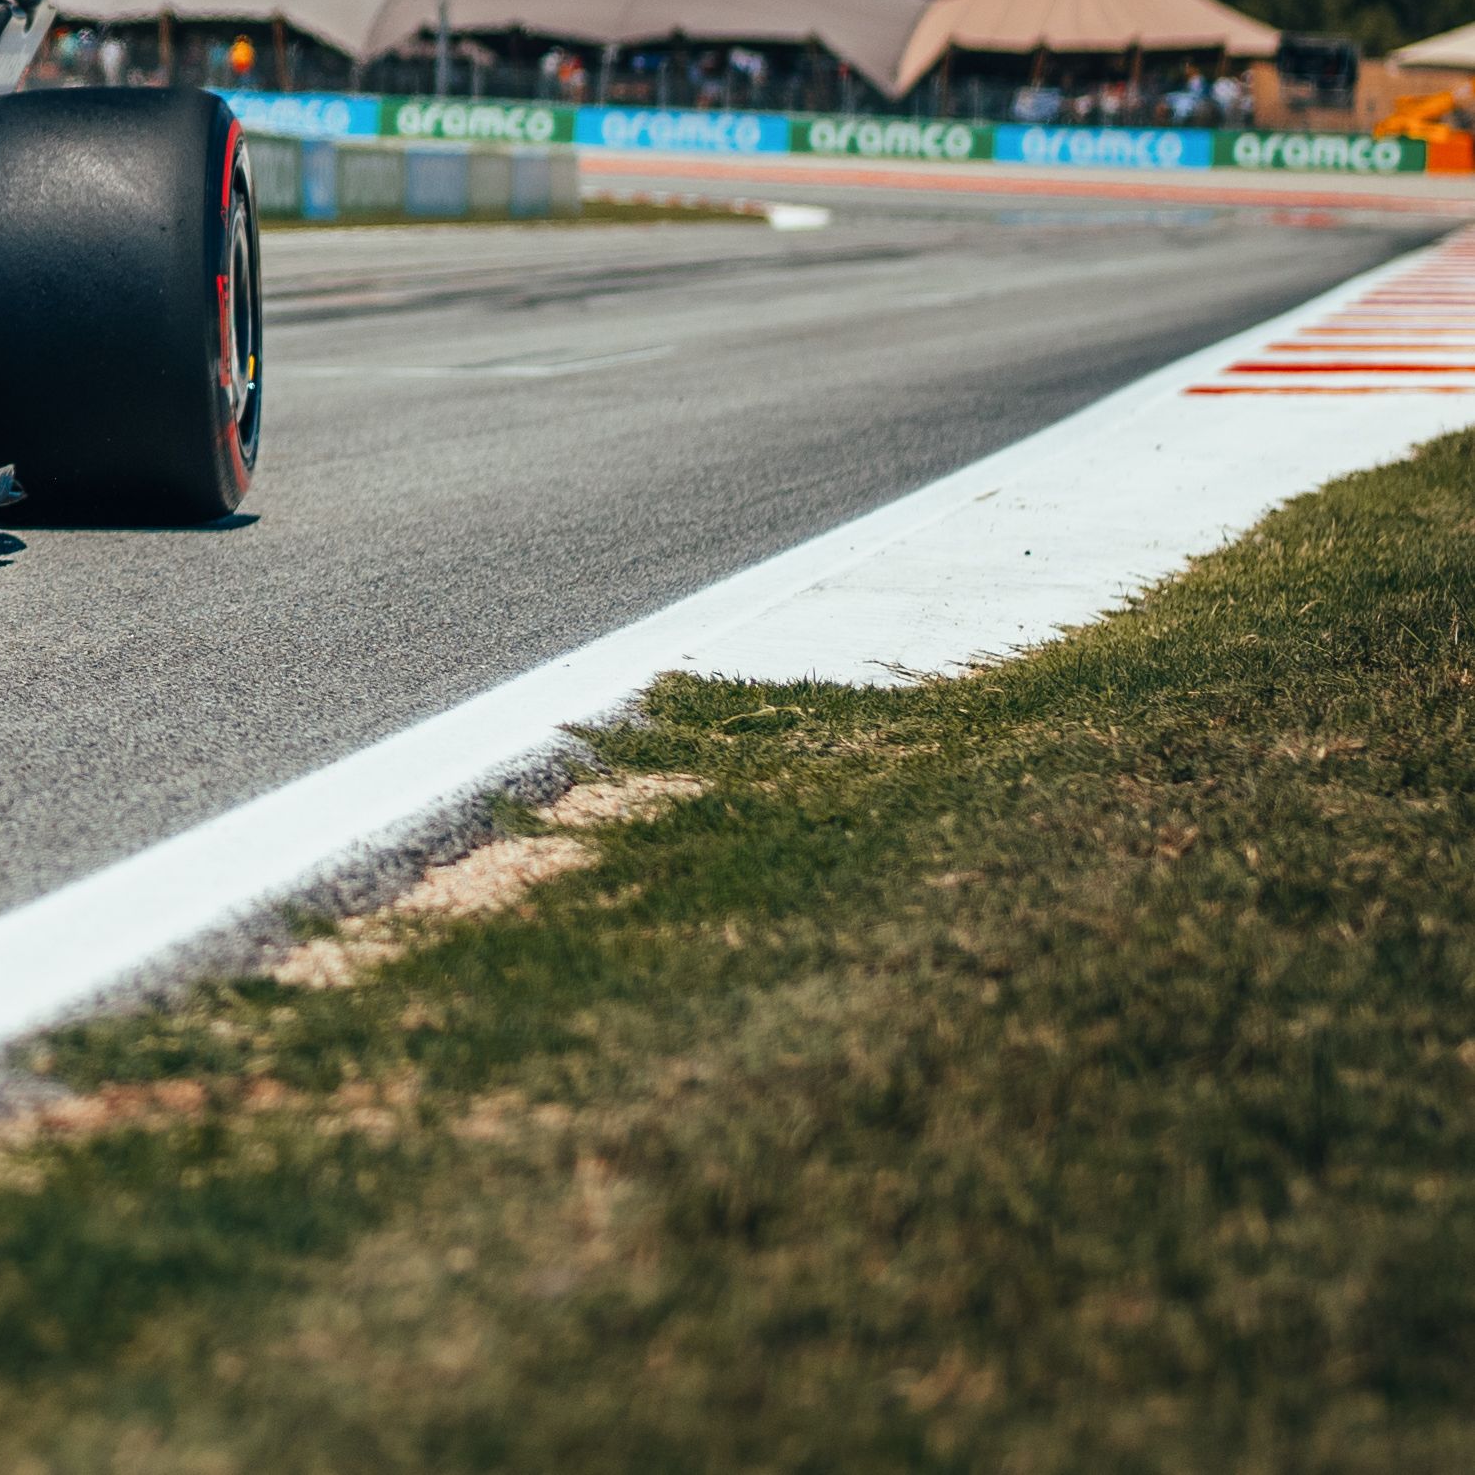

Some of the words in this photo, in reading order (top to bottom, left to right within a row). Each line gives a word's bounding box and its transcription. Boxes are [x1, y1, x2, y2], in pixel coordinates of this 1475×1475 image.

[396, 101, 555, 143] aramco
[601, 110, 761, 151] aramco
[808, 121, 973, 159] aramco
[1021, 125, 1184, 168] aramco
[1234, 132, 1402, 171] aramco
